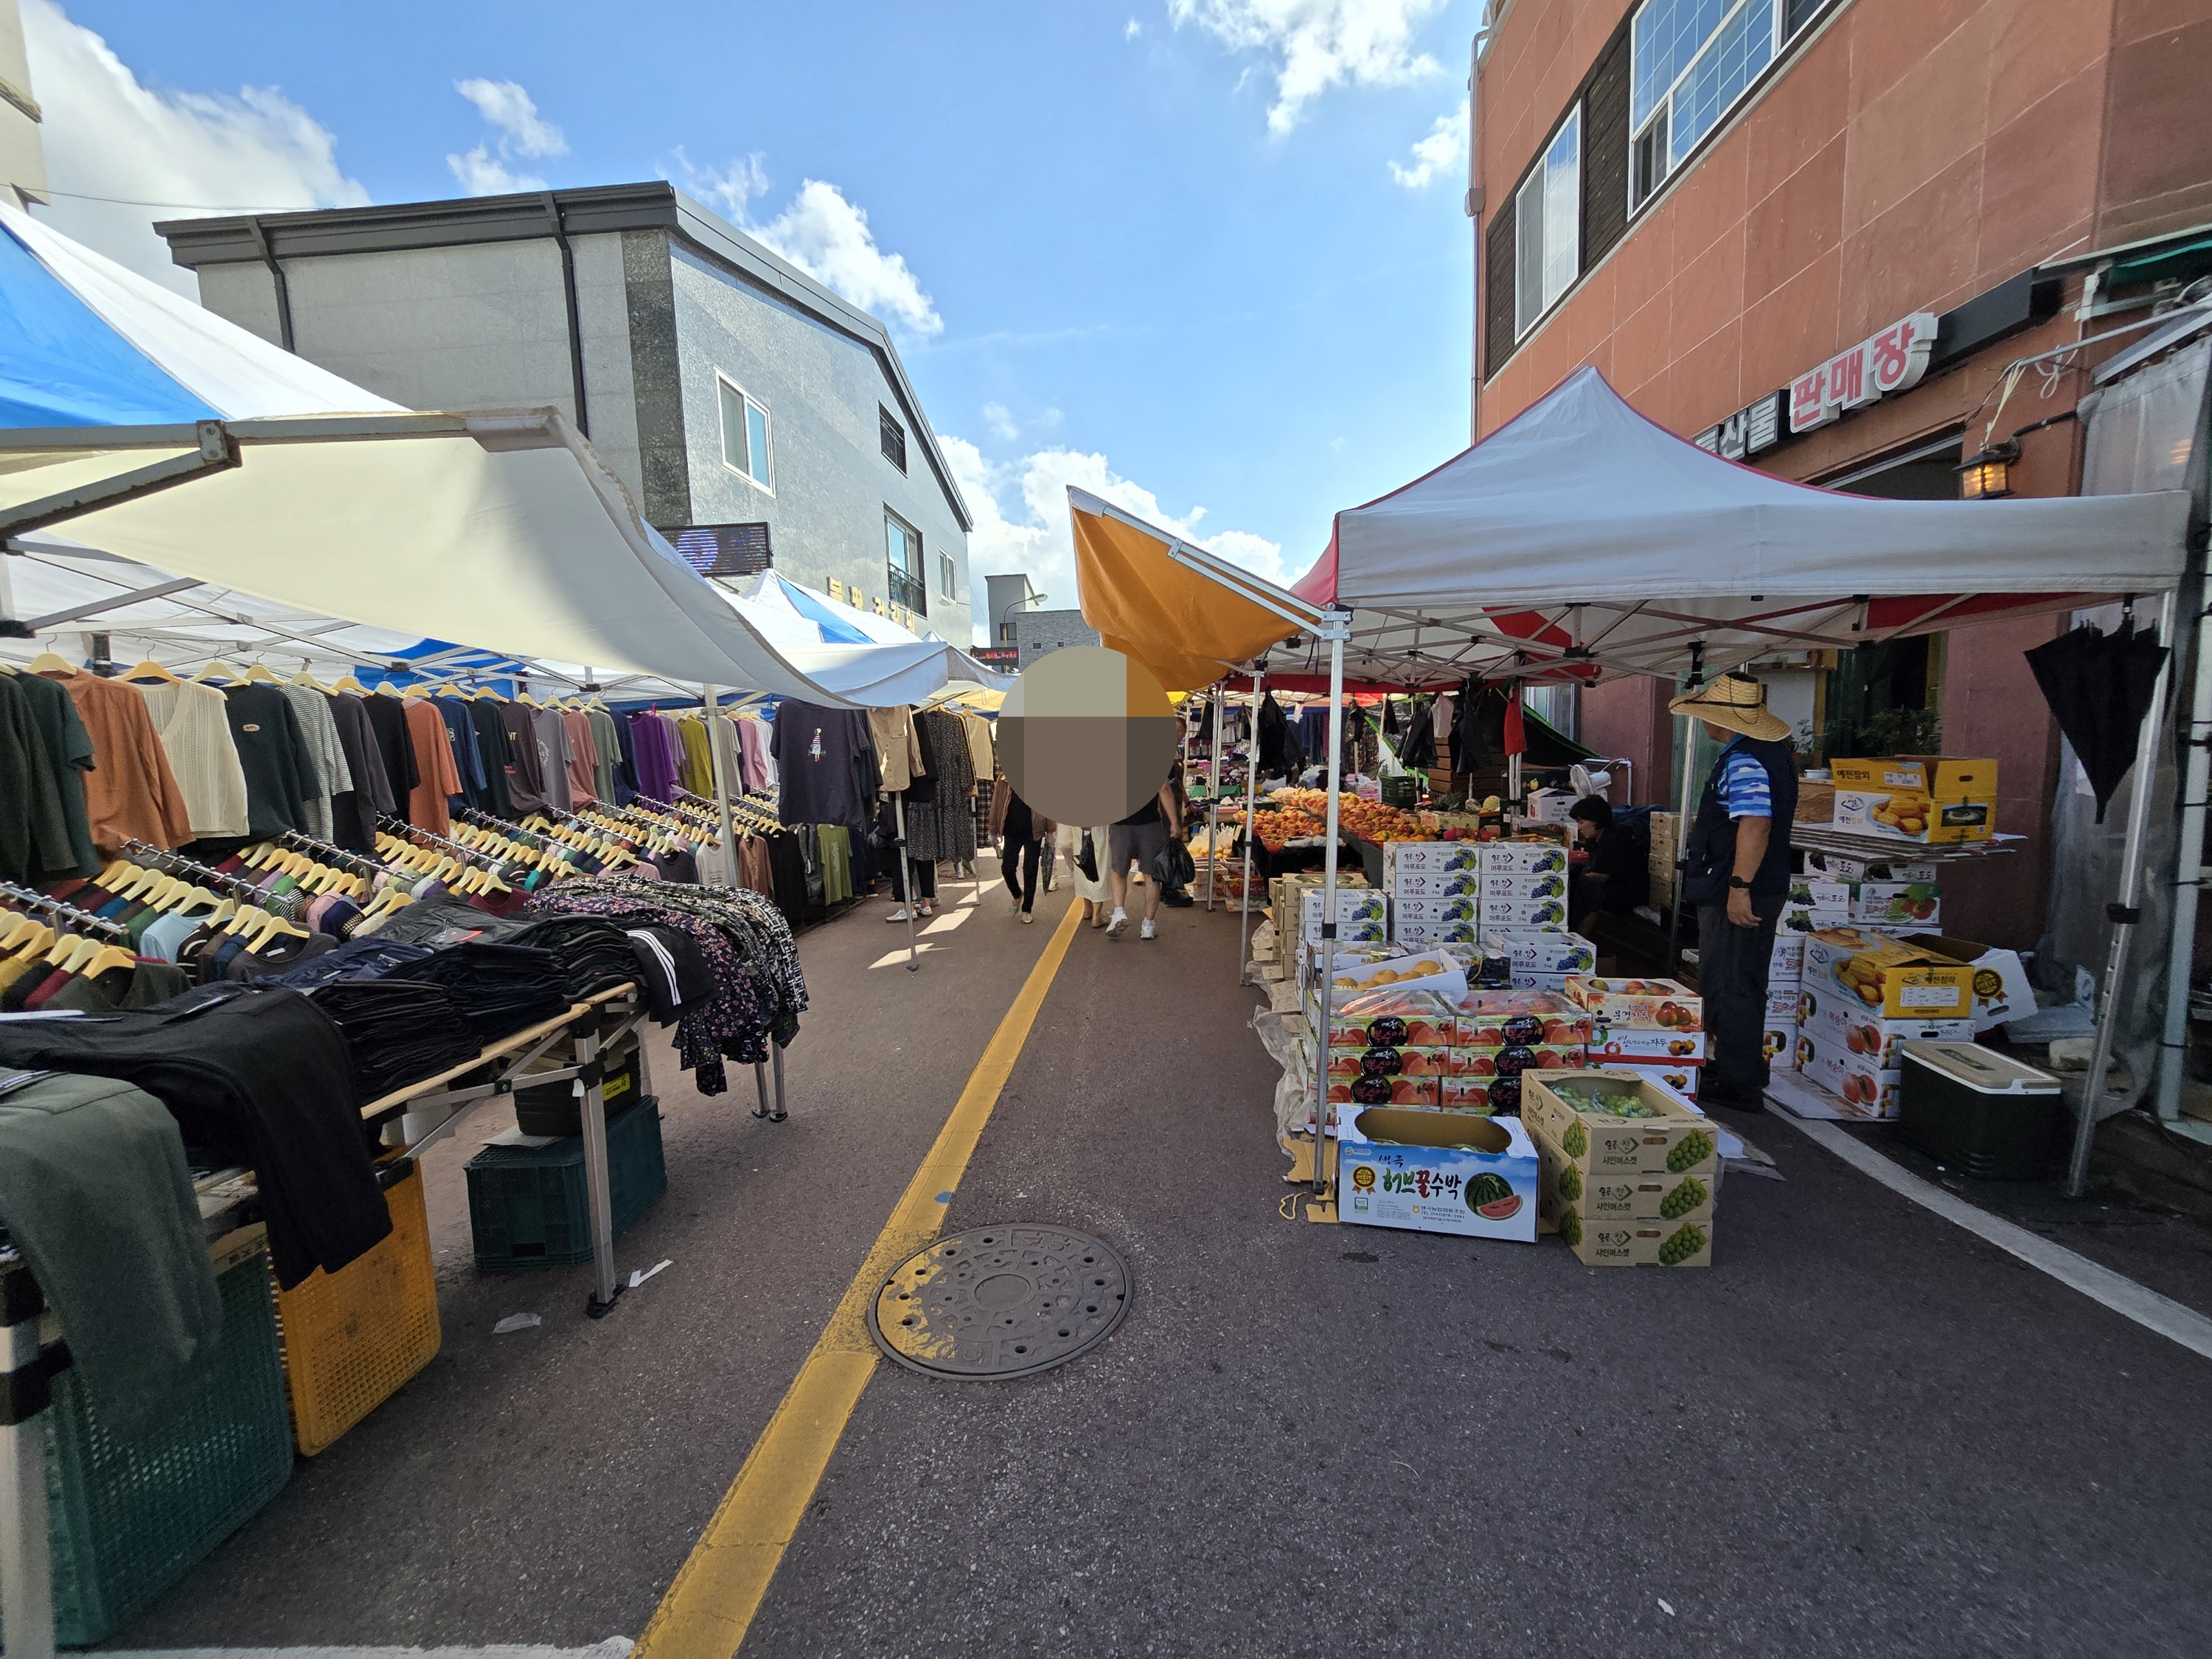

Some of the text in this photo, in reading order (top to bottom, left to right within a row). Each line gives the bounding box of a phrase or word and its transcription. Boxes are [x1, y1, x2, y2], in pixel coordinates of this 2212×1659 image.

[1792, 321, 1916, 428] 판매장
[1837, 769, 1871, 781] 예천참외
[1404, 863, 1426, 871] 머루포도
[1613, 1009, 1649, 1022] 문경자두
[1829, 1011, 1848, 1028] 복숭아
[1373, 1029, 1407, 1045] 복숭아
[1508, 1027, 1542, 1043] 복숭아
[1367, 1058, 1399, 1074] 복숭아
[1500, 1057, 1535, 1074] 복숭아
[1357, 1086, 1391, 1102] 복숭아
[1378, 1155, 1404, 1168] 생극
[1382, 1167, 1462, 1200] 허브꿀수박
